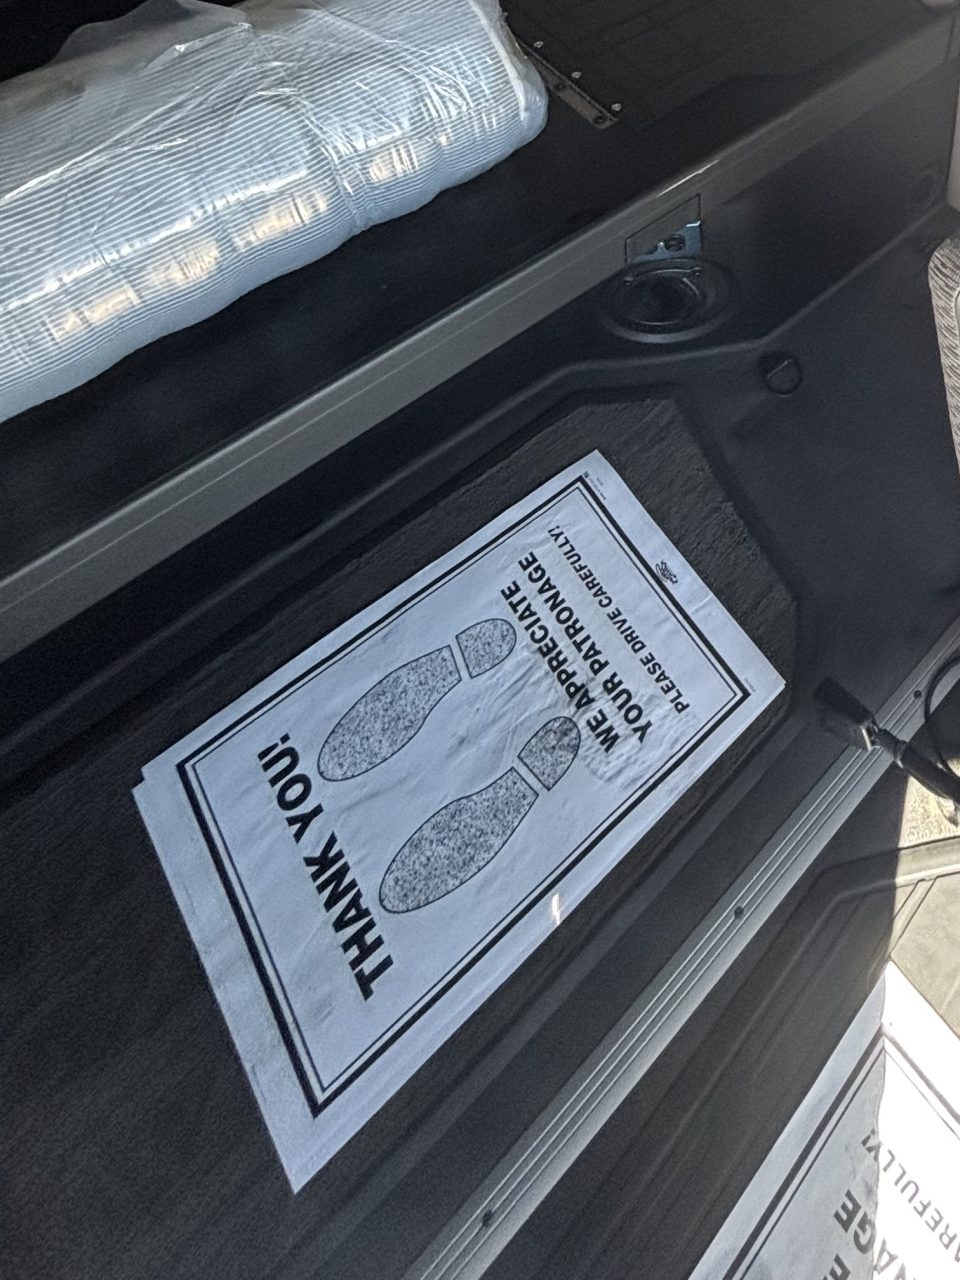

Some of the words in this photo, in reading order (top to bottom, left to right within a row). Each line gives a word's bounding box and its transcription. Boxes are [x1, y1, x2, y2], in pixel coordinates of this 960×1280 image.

[548, 525, 613, 608] CAREFULLY!
[501, 580, 596, 711] APPRECIATE
[518, 551, 610, 676] PATRONAGE
[607, 607, 646, 655] DRIVE
[602, 672, 653, 744] YOUR
[640, 652, 690, 714] PLEASE
[586, 708, 620, 753] WE
[257, 732, 324, 844] YOU!
[303, 830, 394, 1001] THANK
